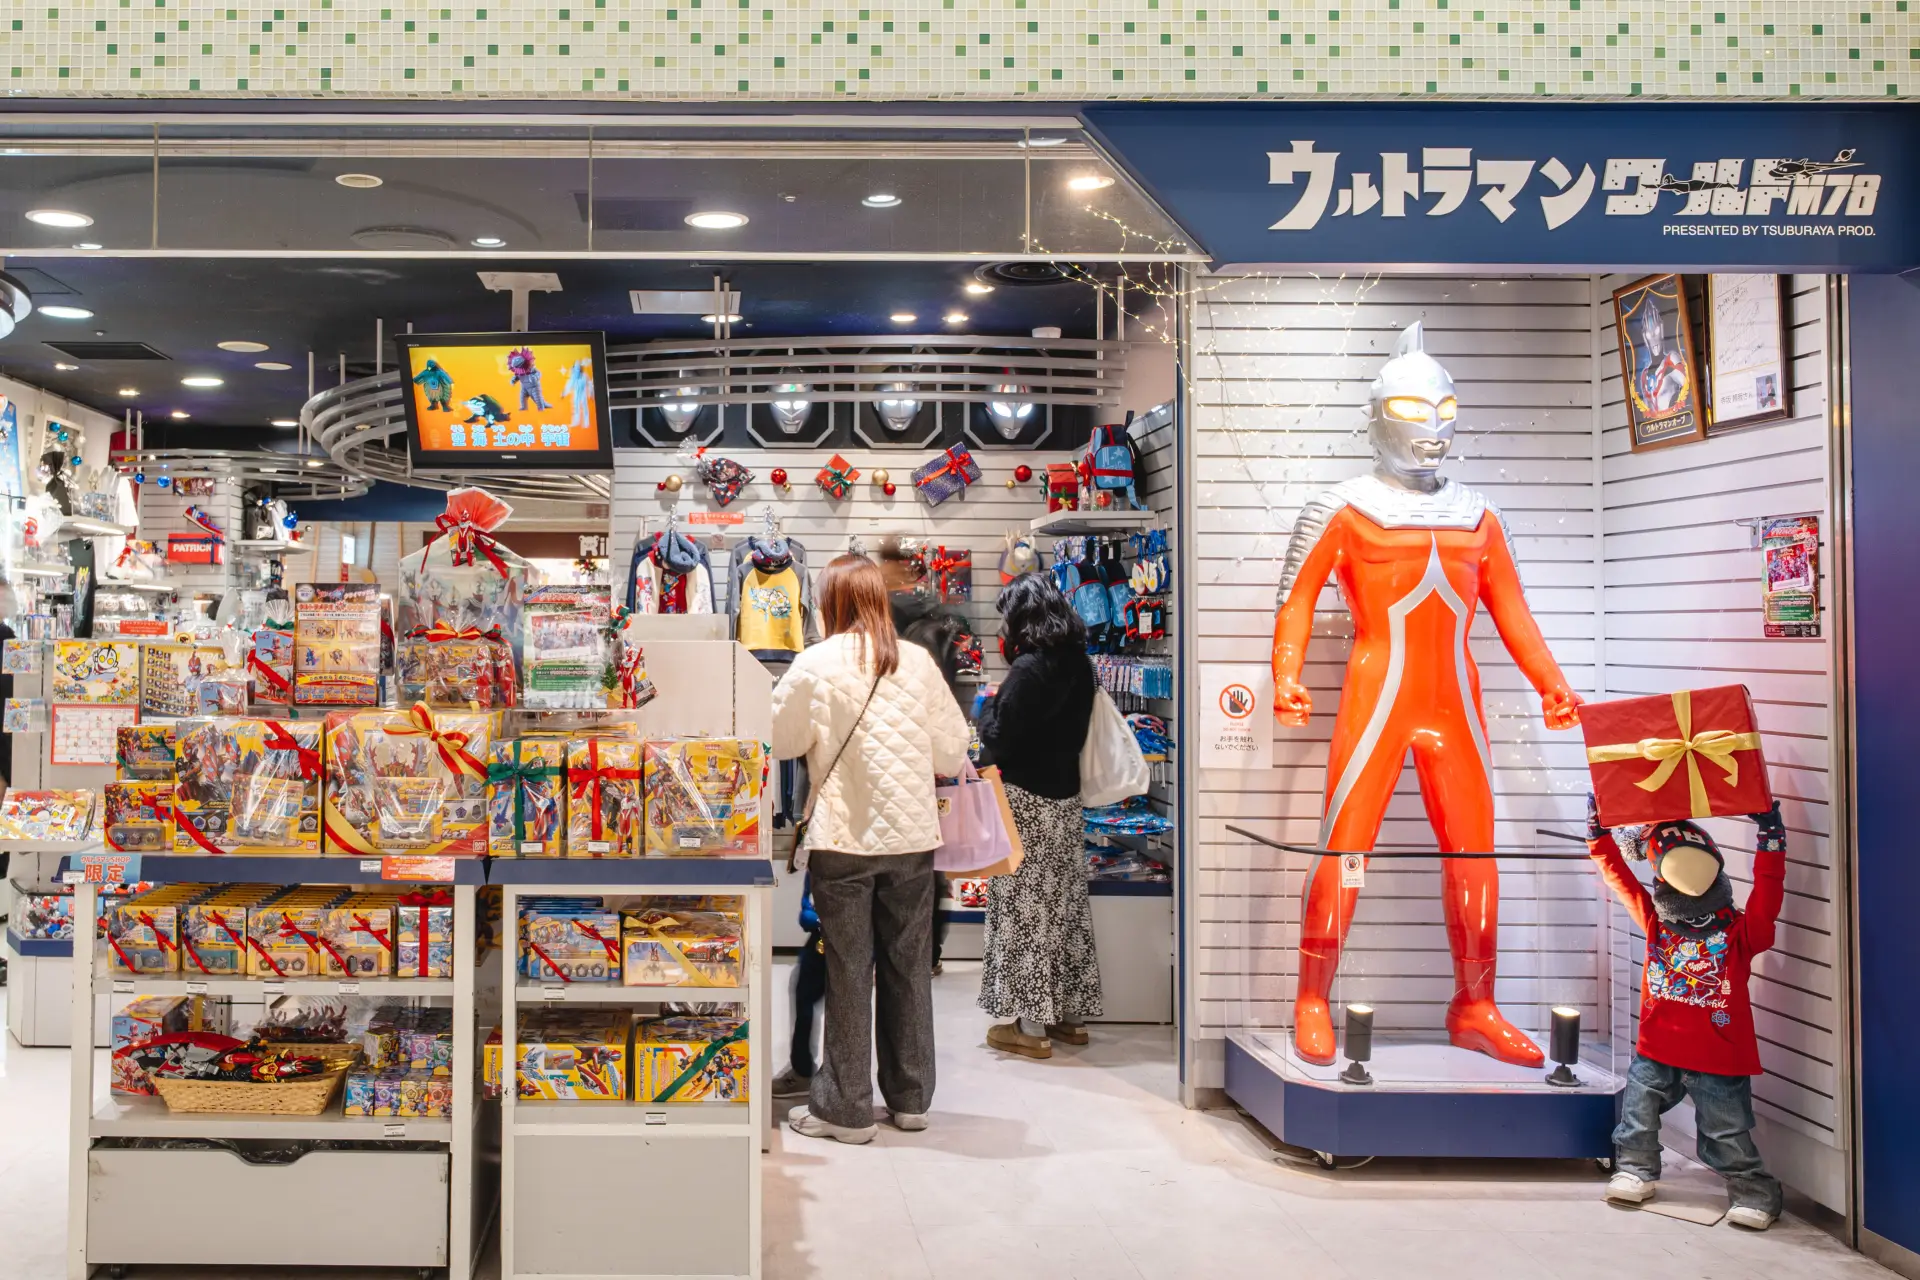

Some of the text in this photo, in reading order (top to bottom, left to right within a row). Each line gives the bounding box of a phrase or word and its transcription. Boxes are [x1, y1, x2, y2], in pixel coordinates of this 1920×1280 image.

[1662, 225, 1877, 236] PRESENTED BY TSUBURAYA PROD.
[1219, 735, 1254, 743] お手を触れ
[1214, 743, 1259, 751] ないでください
[85, 863, 126, 883] 限定
